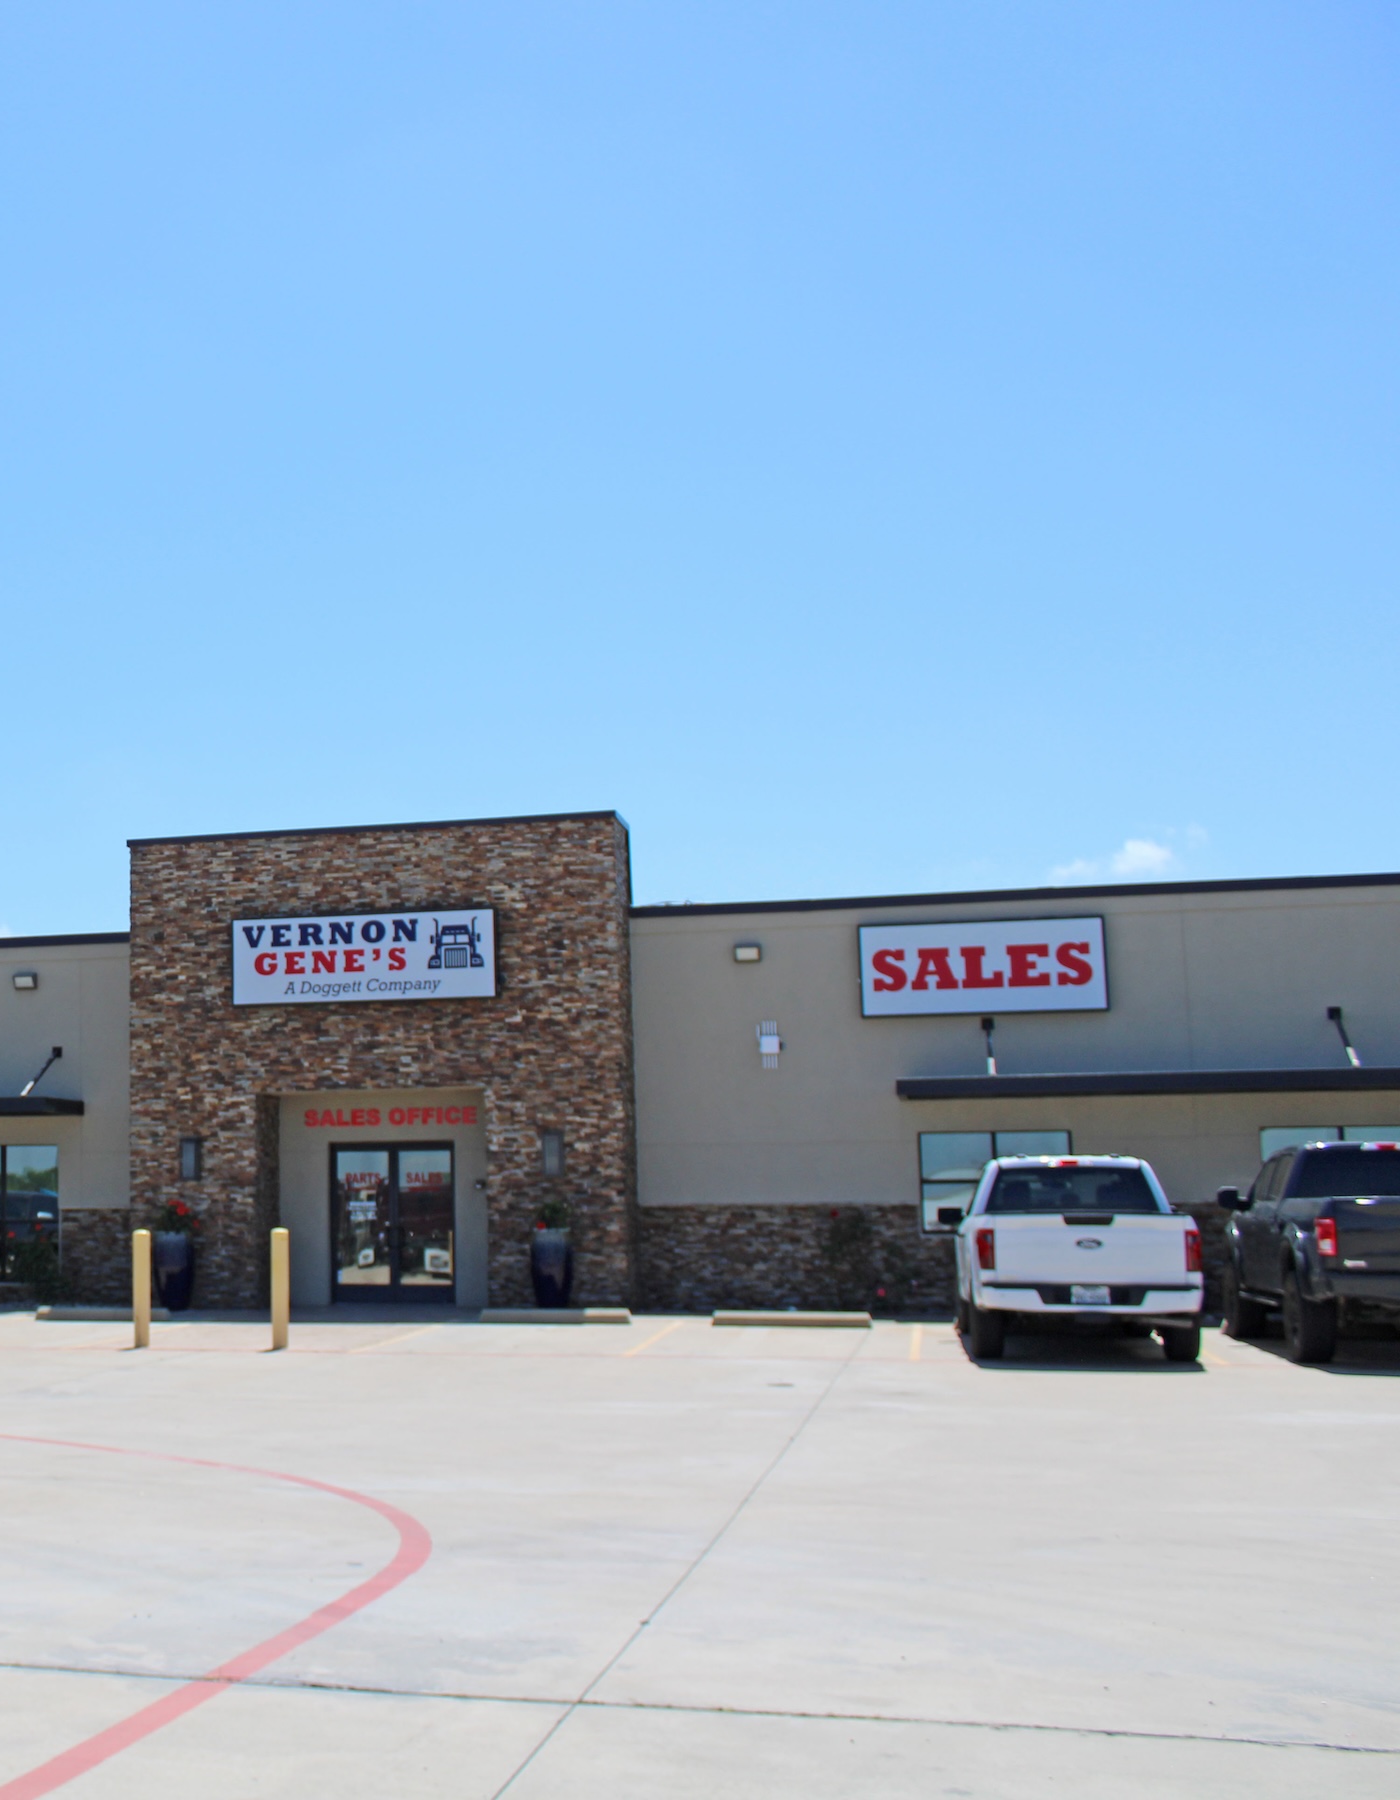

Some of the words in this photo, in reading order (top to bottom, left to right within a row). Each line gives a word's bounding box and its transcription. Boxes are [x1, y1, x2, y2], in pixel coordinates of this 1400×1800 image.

[242, 918, 419, 948] VERNON
[254, 947, 407, 976] GENE'S
[871, 941, 1093, 992] SALES
[284, 981, 296, 995] A
[300, 979, 362, 997] Doggett
[366, 977, 442, 994] Company
[304, 1108, 381, 1127] SALES
[388, 1105, 478, 1126] OFFICE
[345, 1172, 382, 1184] PARTS
[406, 1172, 443, 1184] SALES
